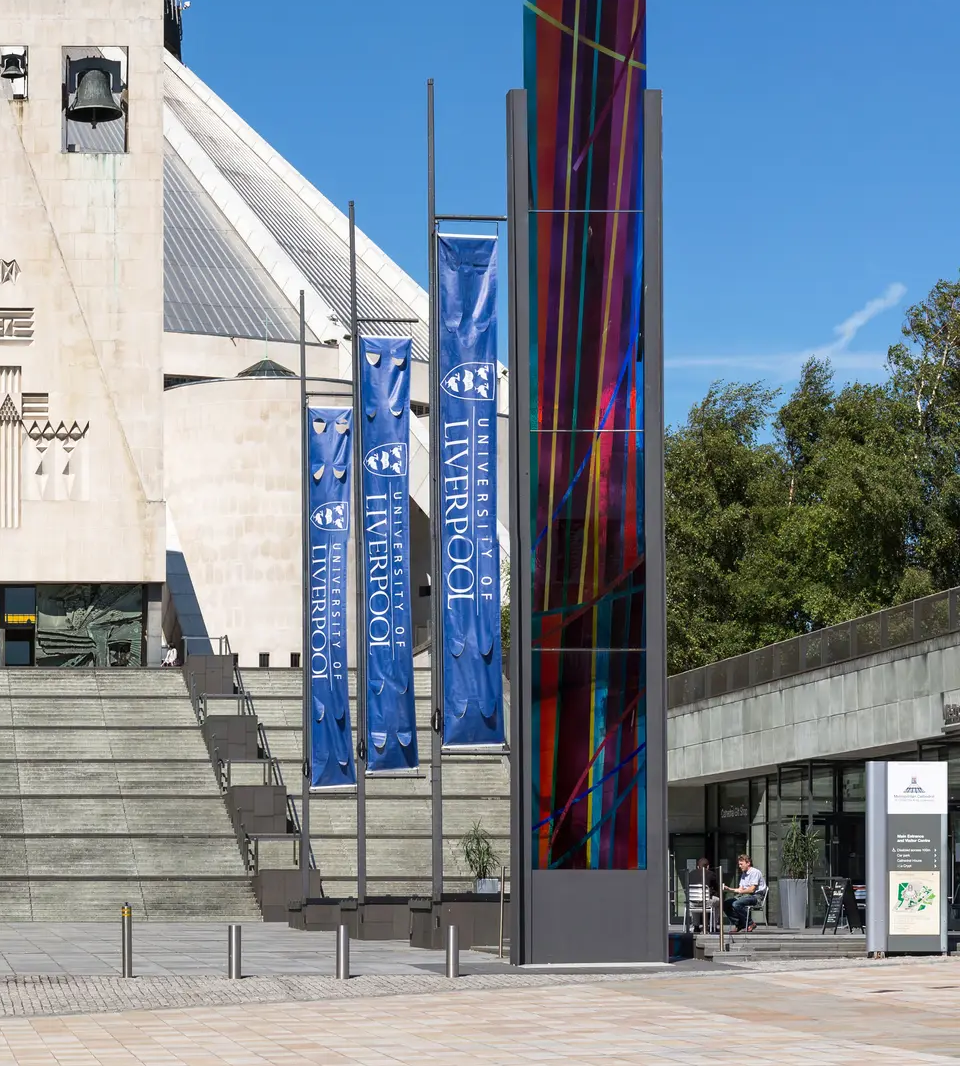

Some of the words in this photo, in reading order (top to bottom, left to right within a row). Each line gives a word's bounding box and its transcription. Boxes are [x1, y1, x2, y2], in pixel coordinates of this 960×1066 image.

[444, 419, 474, 610] LIVERPOOL
[477, 418, 492, 558] UNIVERSITY
[331, 543, 341, 649] UNIVERSITY
[366, 493, 390, 655] LIVERPOOL
[393, 491, 405, 610] UNIVERSITY
[481, 576, 492, 601] OF
[333, 661, 343, 680] OF
[395, 626, 406, 648] OF
